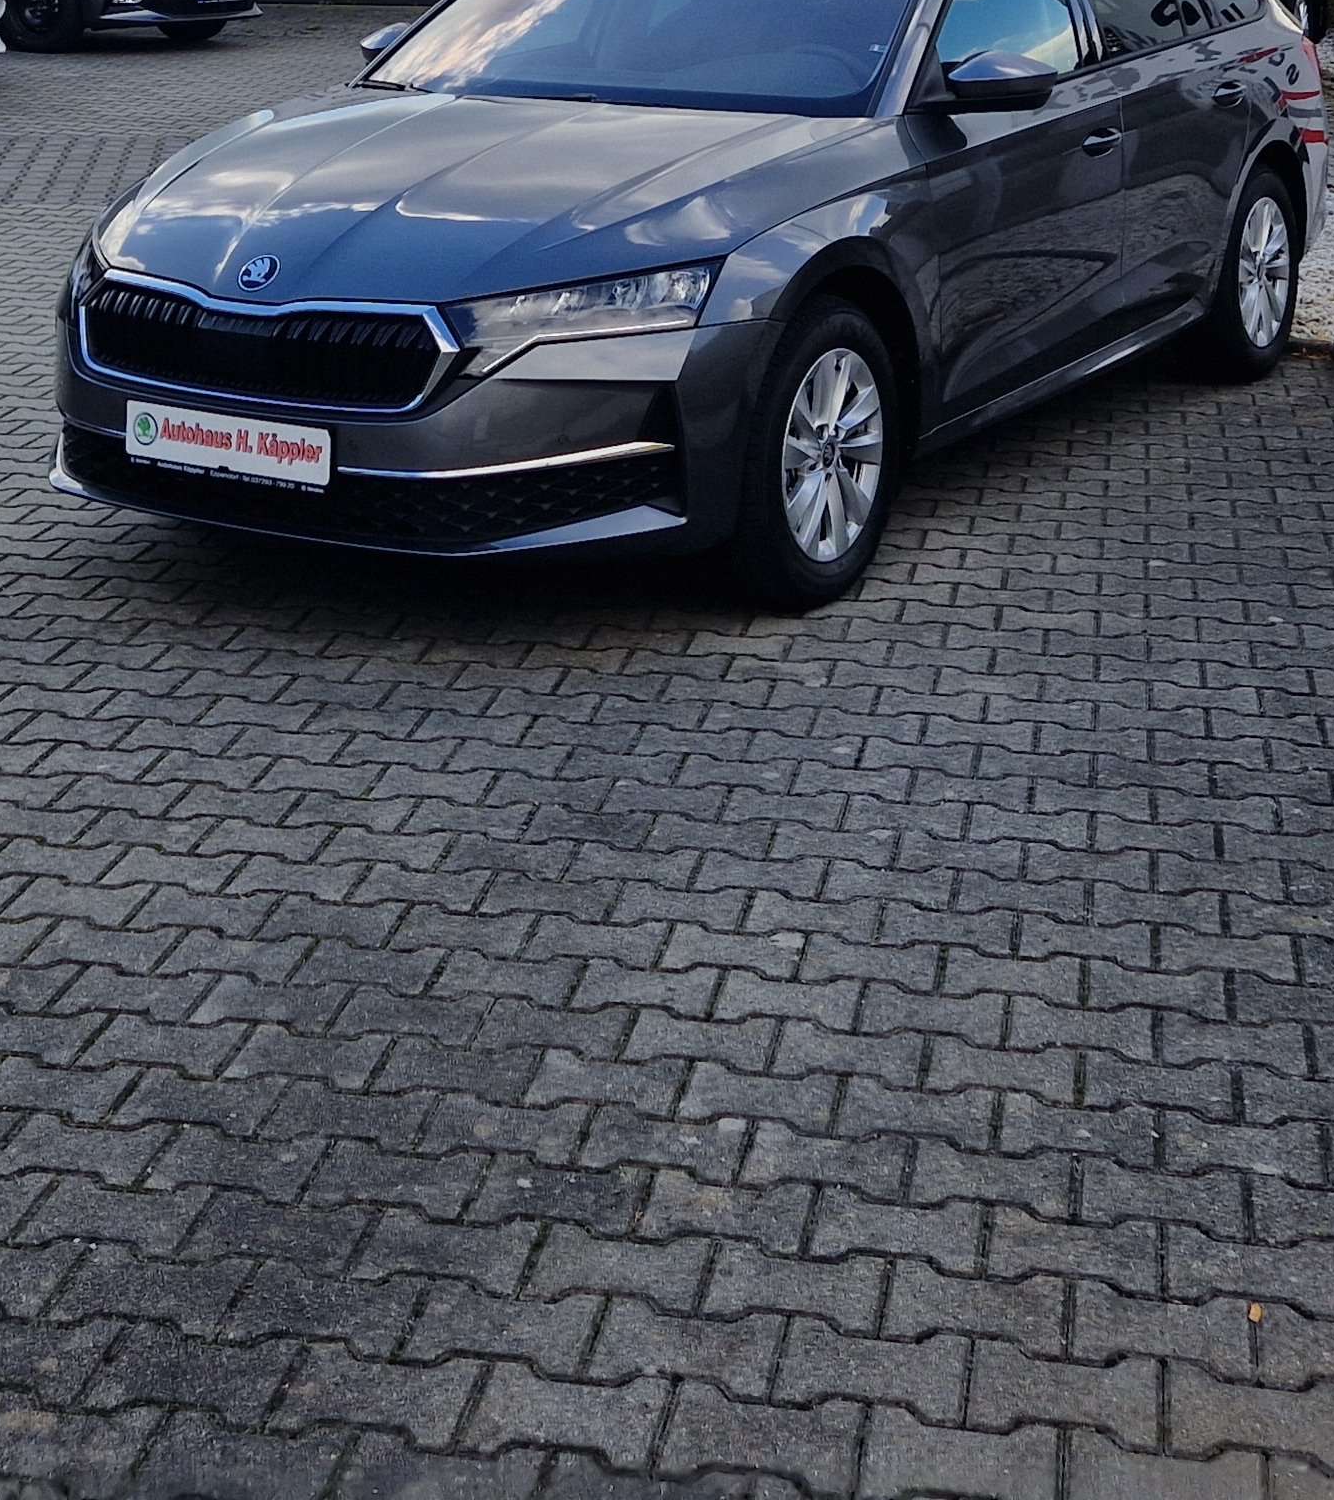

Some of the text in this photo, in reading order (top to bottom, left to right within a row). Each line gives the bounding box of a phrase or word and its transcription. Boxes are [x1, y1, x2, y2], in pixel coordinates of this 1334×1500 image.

[160, 417, 323, 466] Autohaus H. Käppler
